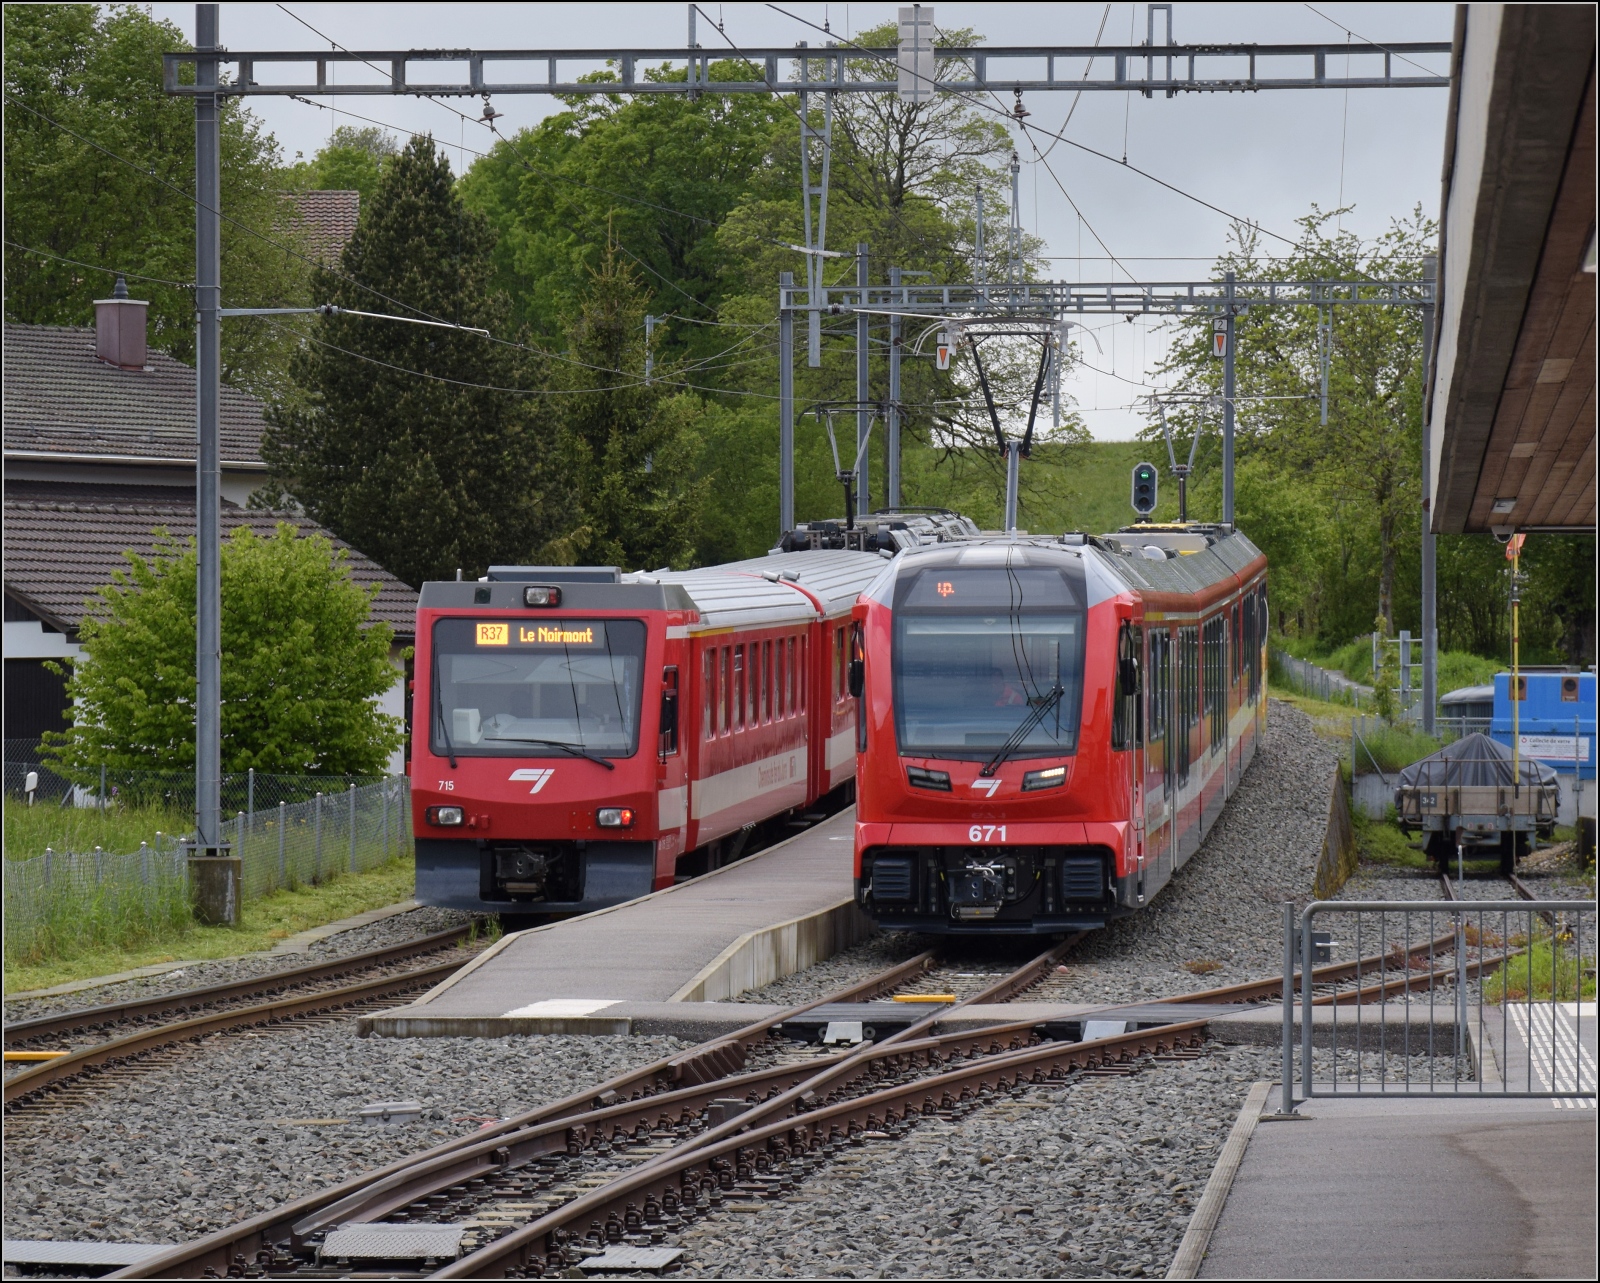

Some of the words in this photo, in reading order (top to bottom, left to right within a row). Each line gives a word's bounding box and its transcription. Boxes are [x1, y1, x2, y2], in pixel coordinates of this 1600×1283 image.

[1217, 320, 1224, 330] 2
[481, 626, 503, 640] R37
[520, 627, 535, 642] Le
[538, 627, 593, 642] Noirmont
[438, 780, 454, 791] 715
[968, 824, 1007, 843] 671
